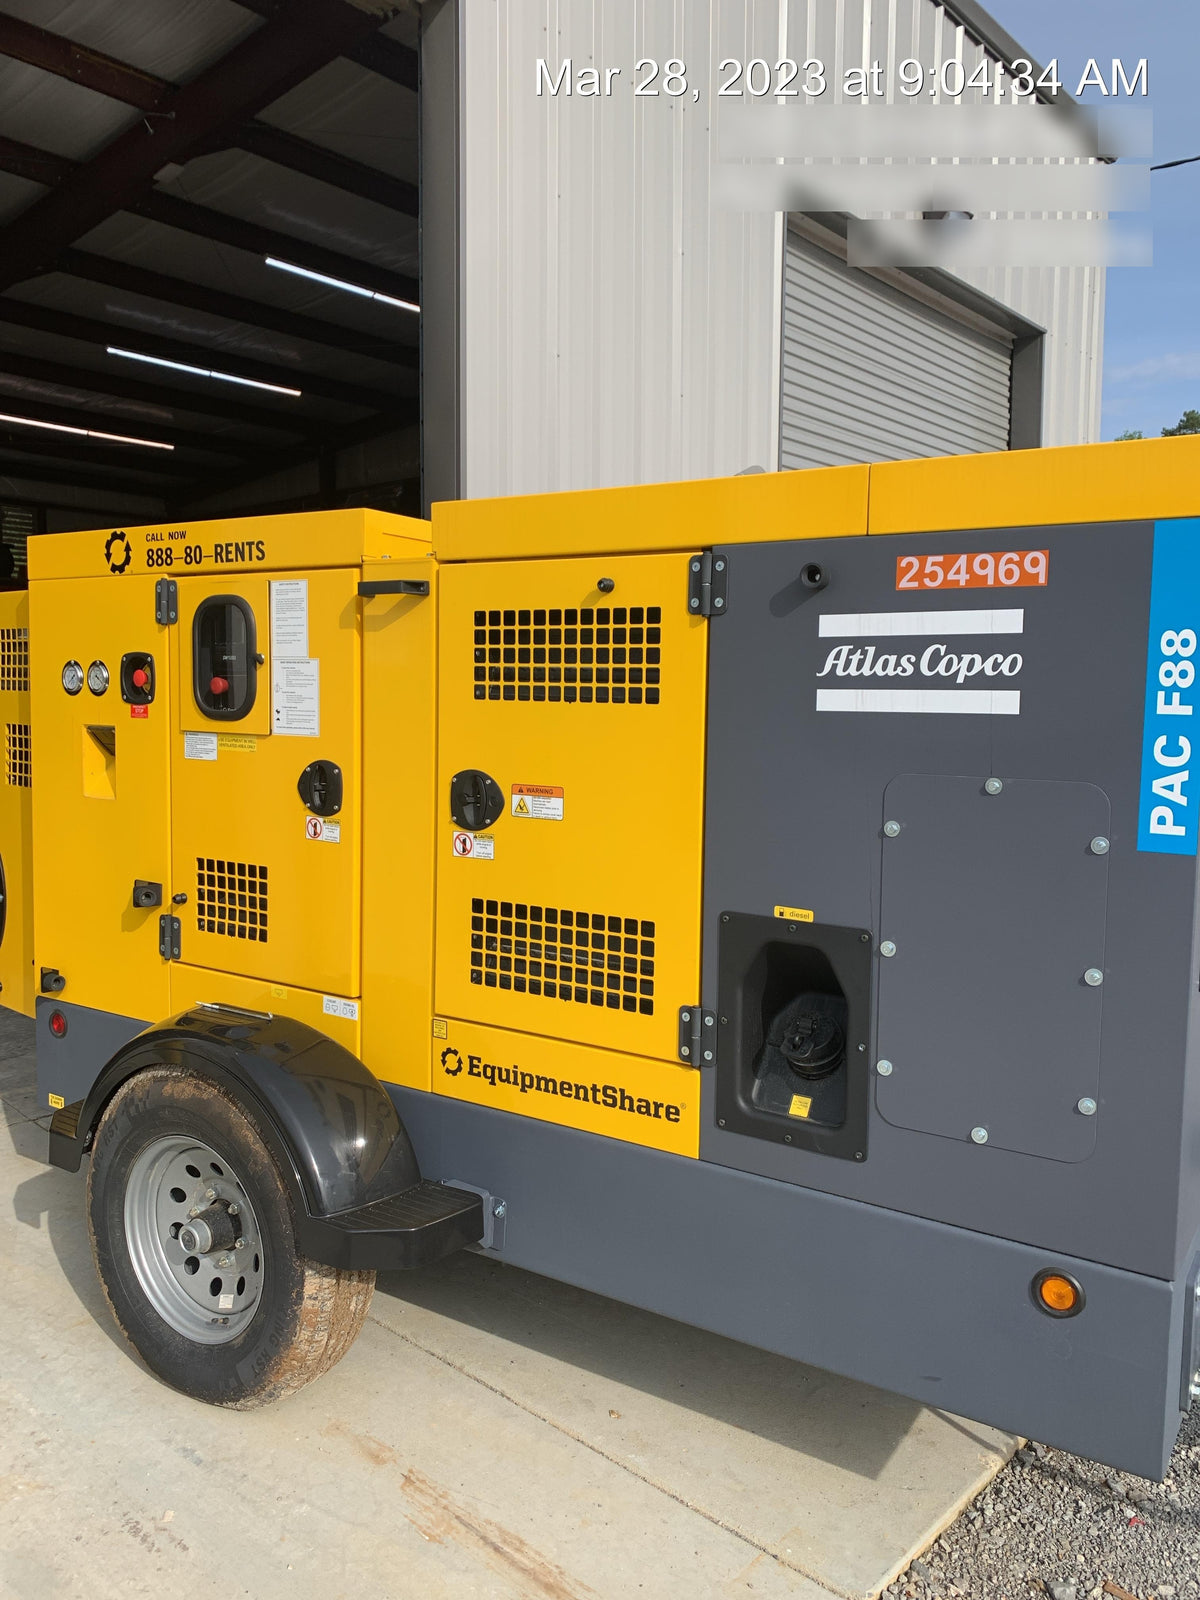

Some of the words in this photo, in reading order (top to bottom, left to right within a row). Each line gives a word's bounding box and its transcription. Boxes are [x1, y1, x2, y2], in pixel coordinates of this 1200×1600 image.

[145, 531, 165, 542] CALL
[168, 530, 187, 541] NOW
[898, 551, 1047, 588] 254969
[816, 644, 917, 677] Atlas
[919, 643, 1024, 684] Copco
[1156, 628, 1198, 716] F88
[526, 787, 554, 795] WARNING
[1149, 734, 1192, 837] PAC
[789, 910, 810, 920] diesel
